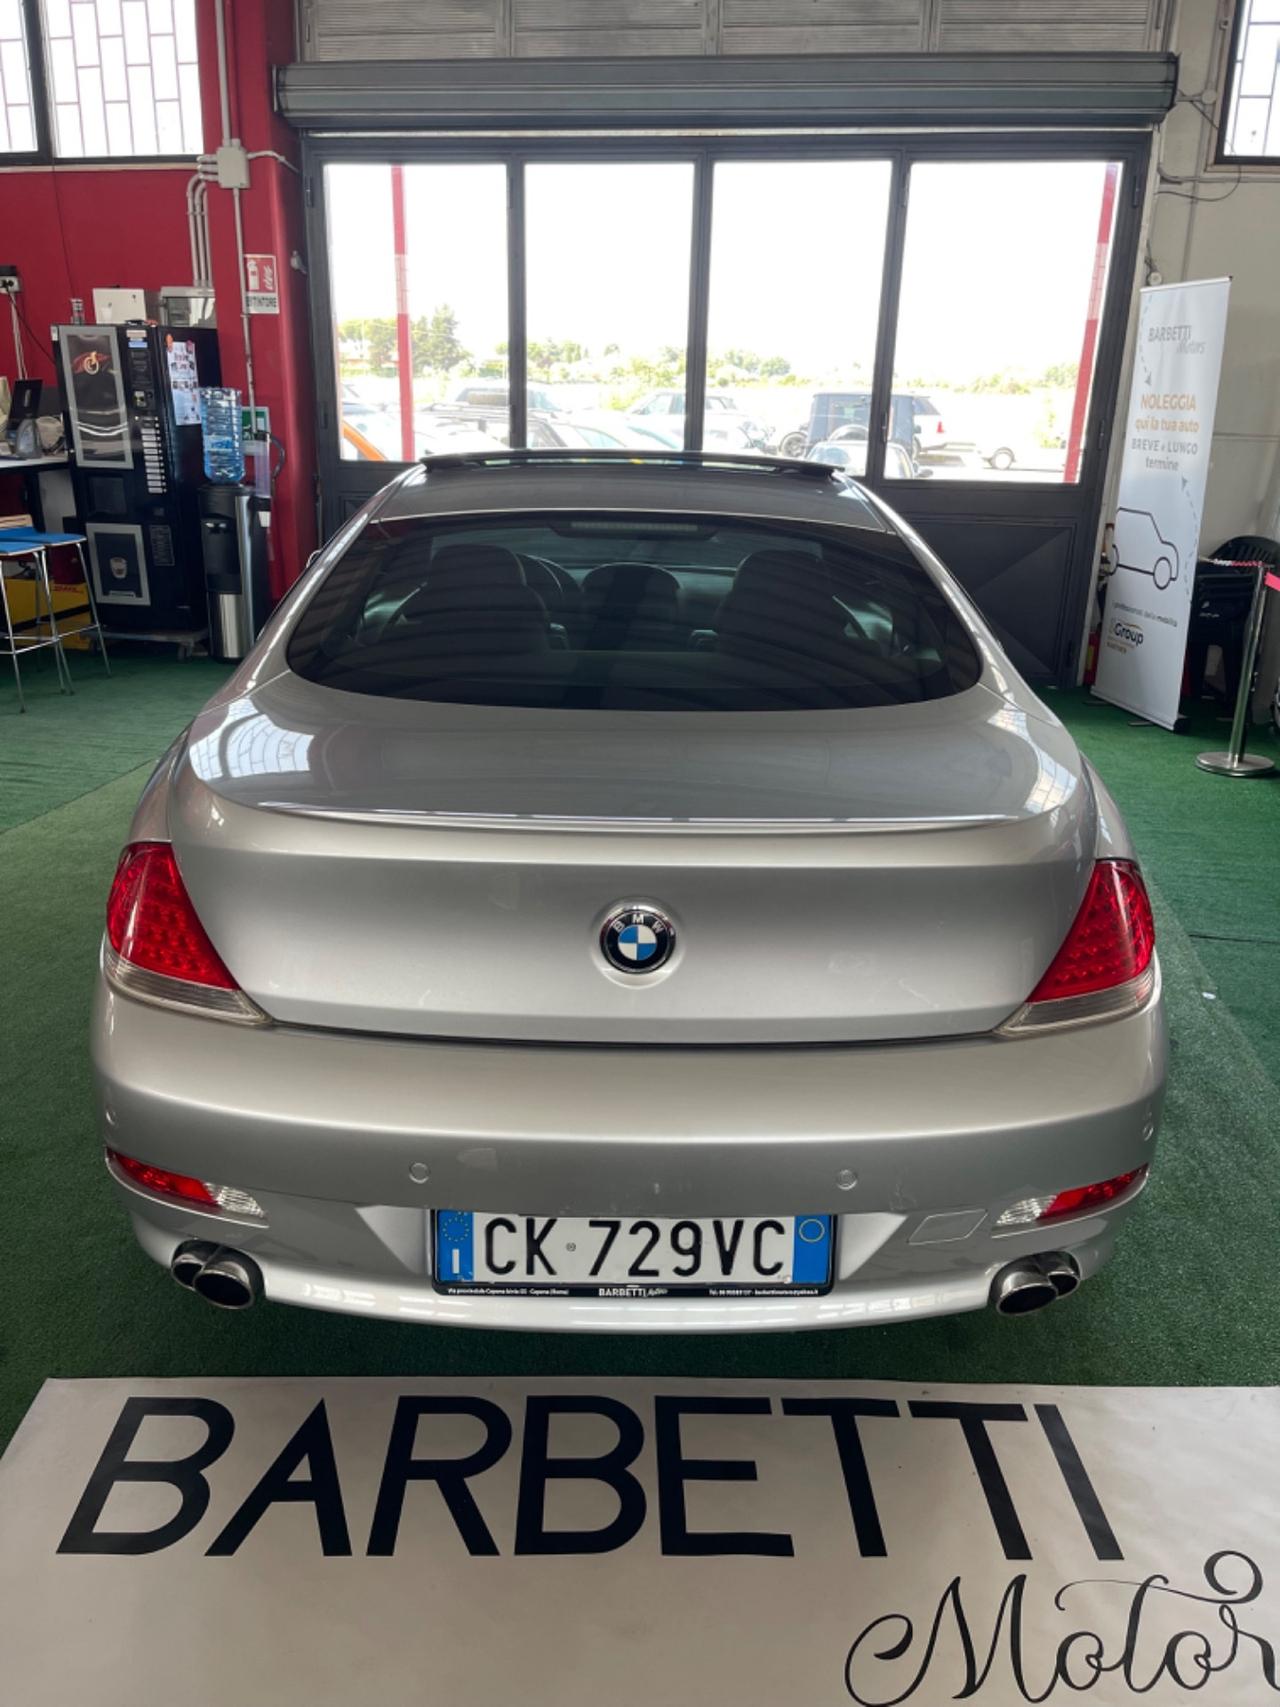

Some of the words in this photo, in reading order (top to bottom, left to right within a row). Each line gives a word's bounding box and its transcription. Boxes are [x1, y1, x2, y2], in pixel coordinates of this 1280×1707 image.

[1148, 325, 1192, 342] BARBETTI
[1141, 394, 1196, 411] NOLEGGIA
[1132, 438, 1160, 452] BREVE
[1167, 441, 1198, 455] LUNGO
[1145, 456, 1179, 471] termine
[613, 913, 665, 933] BMW
[485, 1217, 558, 1276] CK
[588, 1219, 786, 1277] 729VC
[598, 1287, 646, 1297] BARBETTI
[56, 1395, 1125, 1561] BARBETTI
